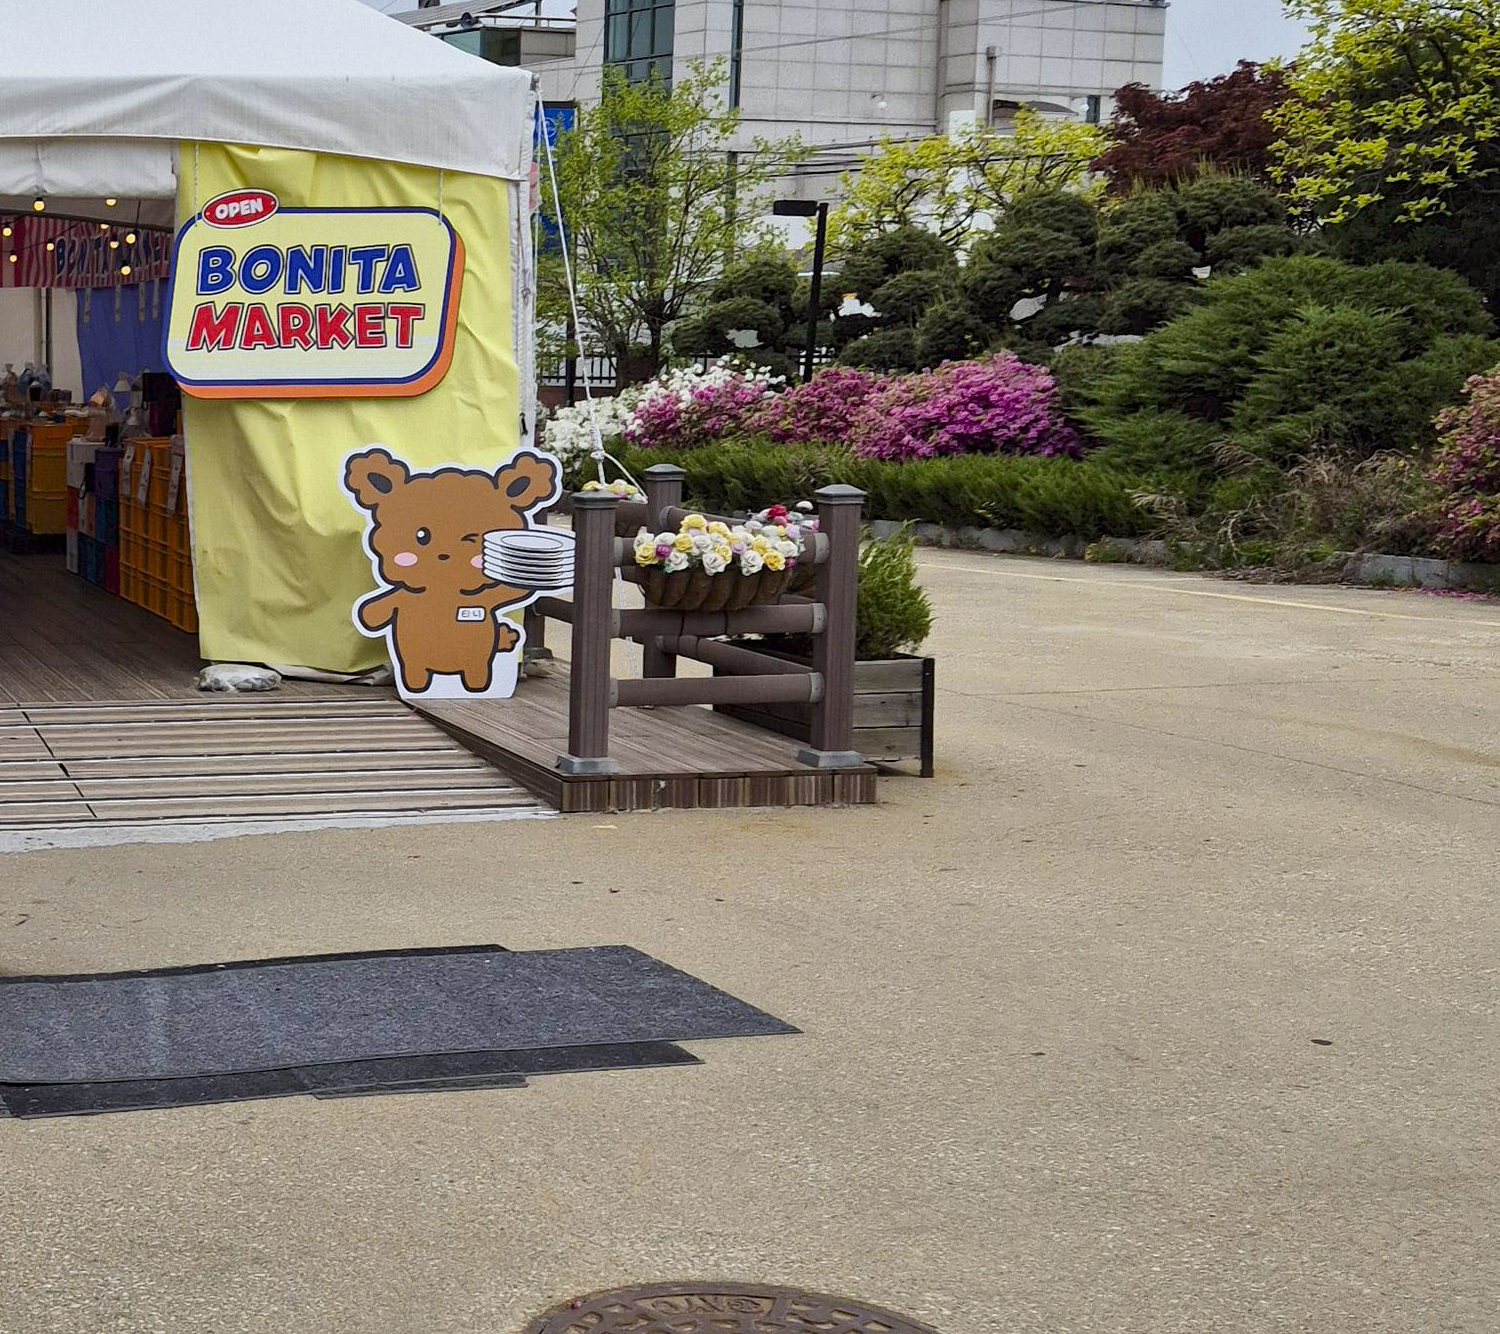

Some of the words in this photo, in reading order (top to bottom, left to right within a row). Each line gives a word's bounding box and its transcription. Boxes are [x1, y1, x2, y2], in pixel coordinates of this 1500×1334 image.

[214, 197, 264, 220] OPEN
[197, 243, 422, 296] BONITA
[186, 301, 425, 352] MARKET
